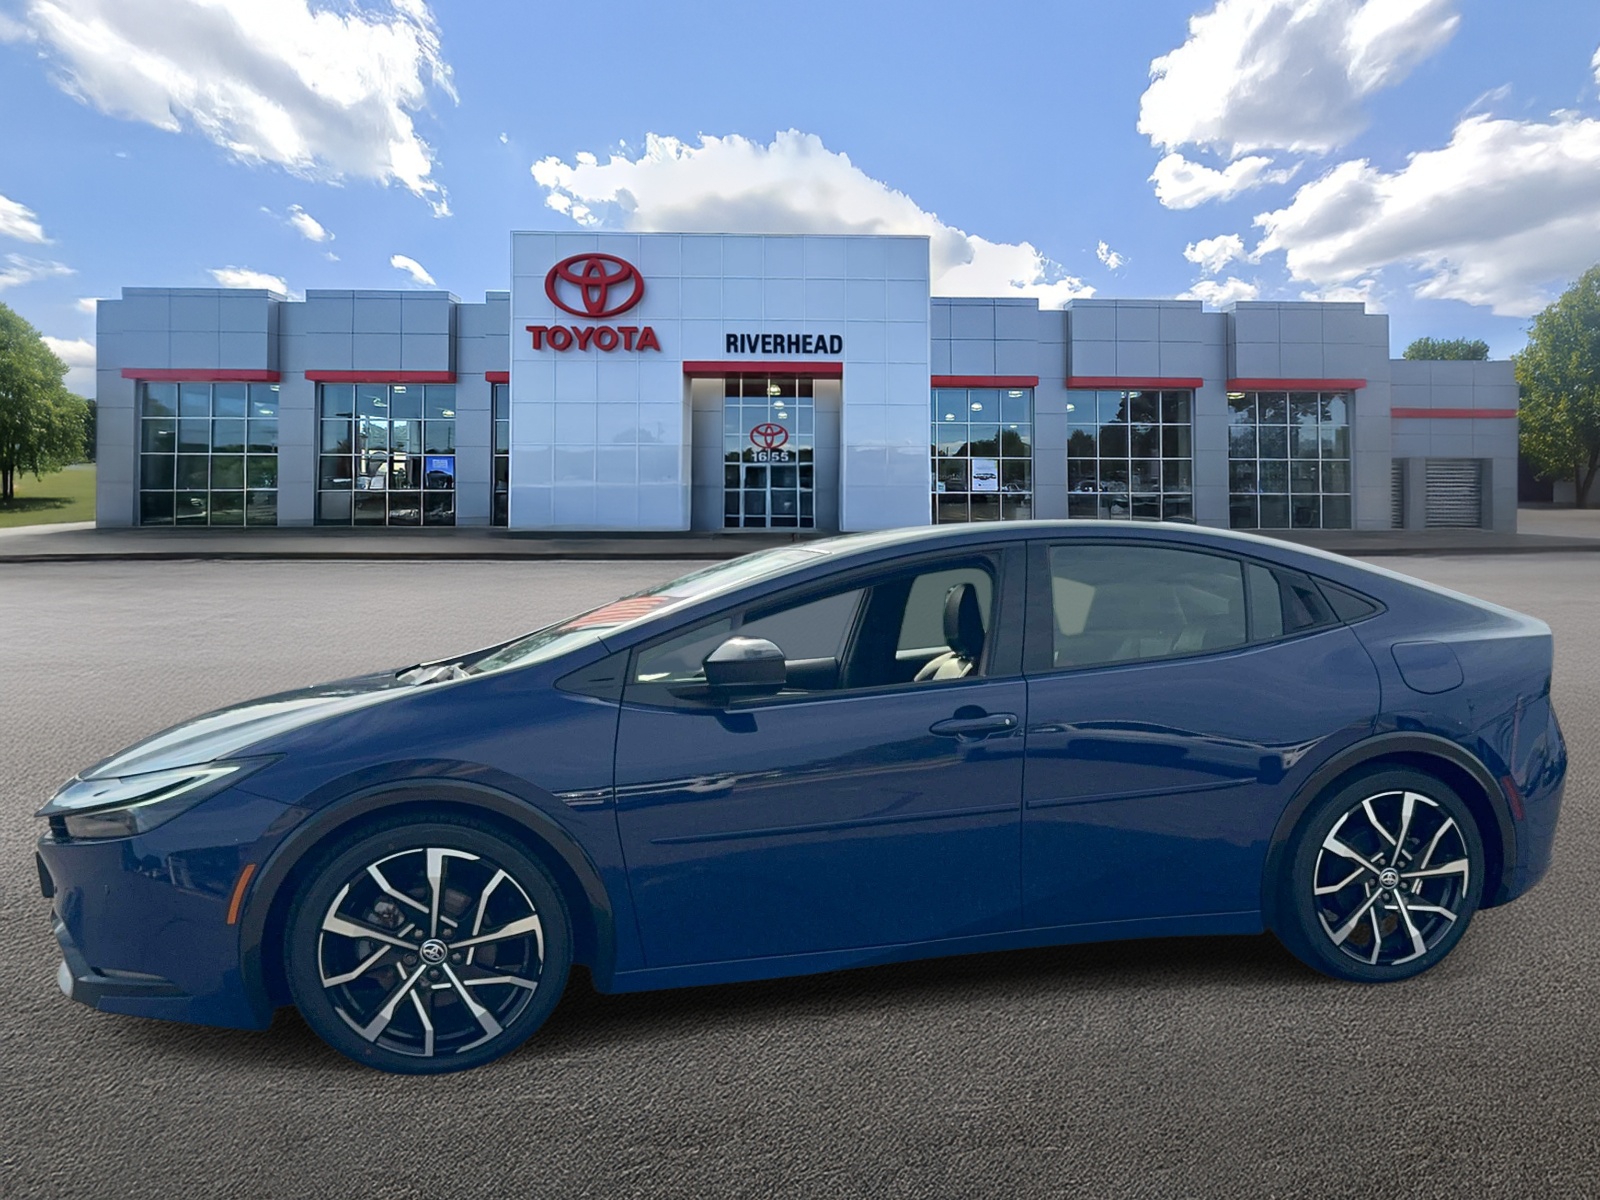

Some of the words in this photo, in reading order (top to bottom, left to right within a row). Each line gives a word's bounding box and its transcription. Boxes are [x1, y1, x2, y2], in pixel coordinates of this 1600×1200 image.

[526, 325, 660, 351] TOYOTA
[726, 333, 843, 354] RIVERHEAD
[752, 452, 789, 462] 1655
